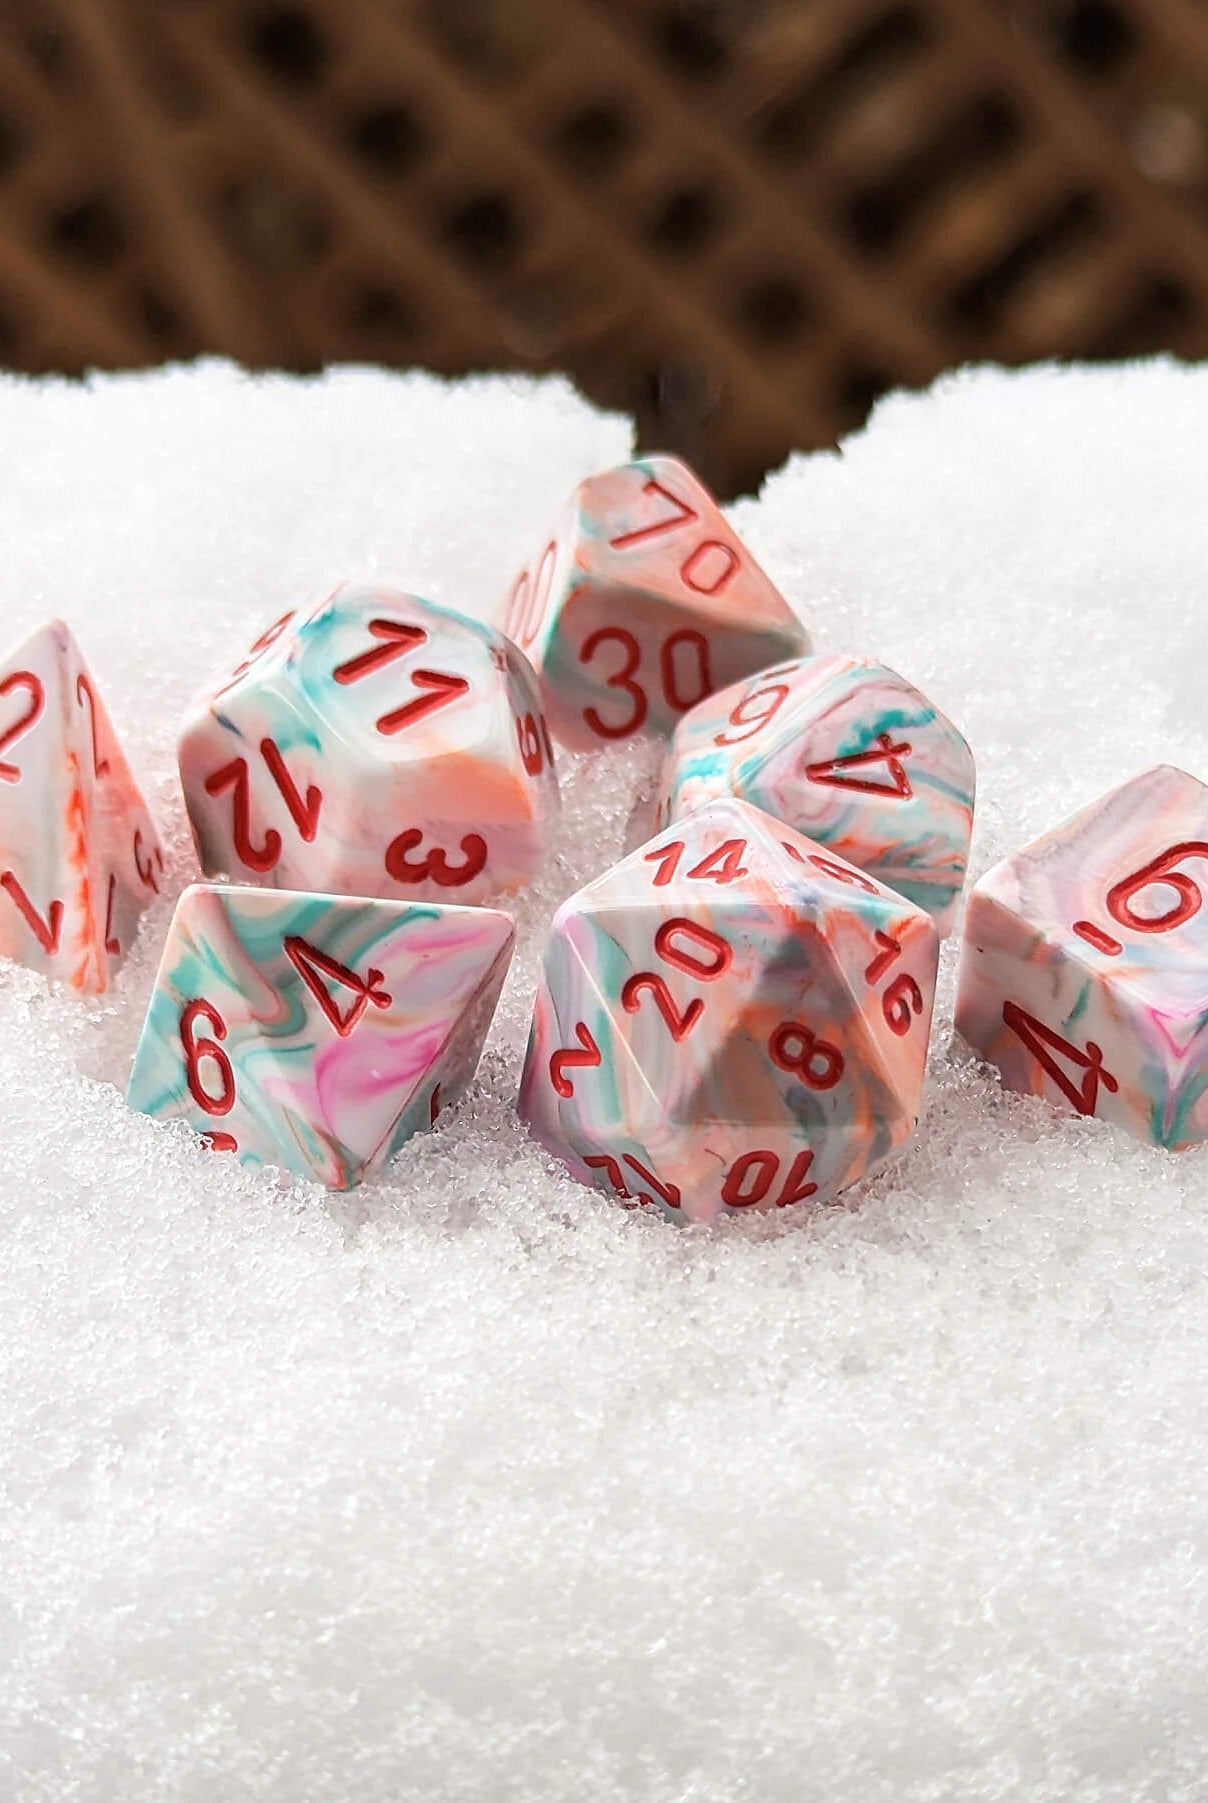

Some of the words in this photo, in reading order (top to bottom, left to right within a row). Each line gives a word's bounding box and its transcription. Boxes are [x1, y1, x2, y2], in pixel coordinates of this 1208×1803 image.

[608, 480, 740, 596] 70
[332, 618, 470, 736] 11
[579, 626, 715, 740] 30
[204, 737, 324, 873] 12
[804, 733, 913, 801] 4
[384, 828, 489, 888] 3
[644, 838, 749, 888] 14
[1, 870, 65, 957] 1
[283, 935, 394, 1039] 4
[621, 916, 734, 1044] 20
[864, 929, 924, 1037] 16
[179, 996, 239, 1118] 6
[548, 1021, 602, 1099] 2
[768, 1021, 845, 1091] 8
[1001, 1000, 1120, 1118] 4
[720, 1149, 819, 1209] 10
